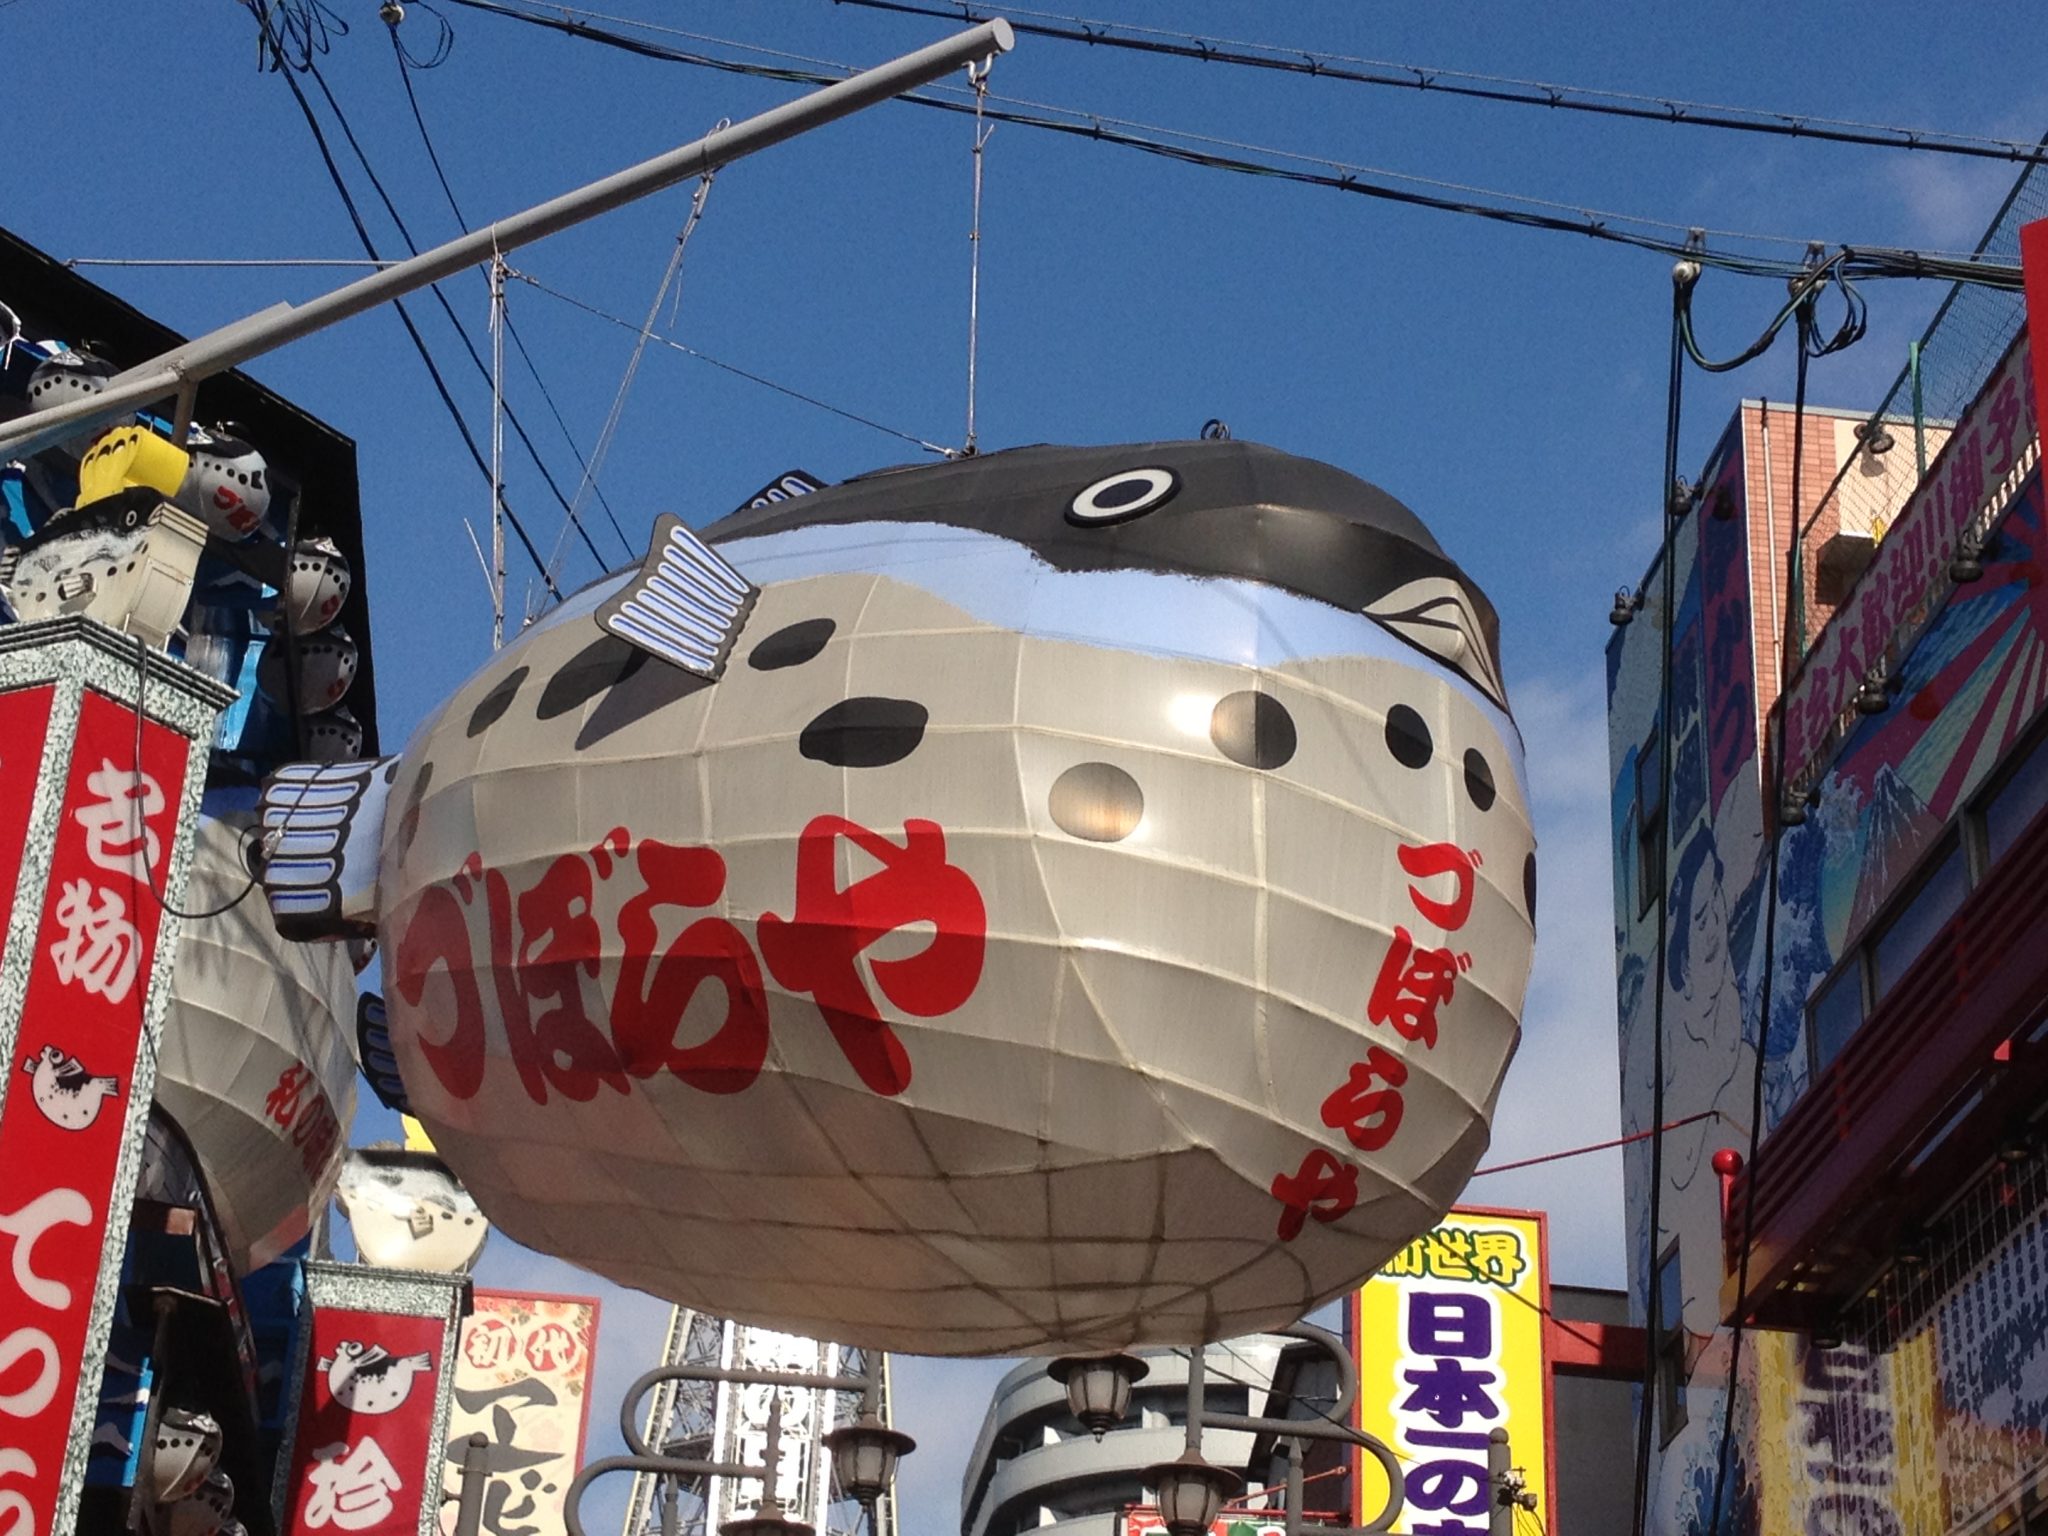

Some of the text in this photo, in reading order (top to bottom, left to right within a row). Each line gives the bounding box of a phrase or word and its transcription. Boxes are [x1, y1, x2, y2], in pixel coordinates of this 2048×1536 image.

[399, 813, 987, 1097] づぼらや
[1272, 842, 1484, 1242] づぼらや
[1400, 1291, 1500, 1536] 日本一の
